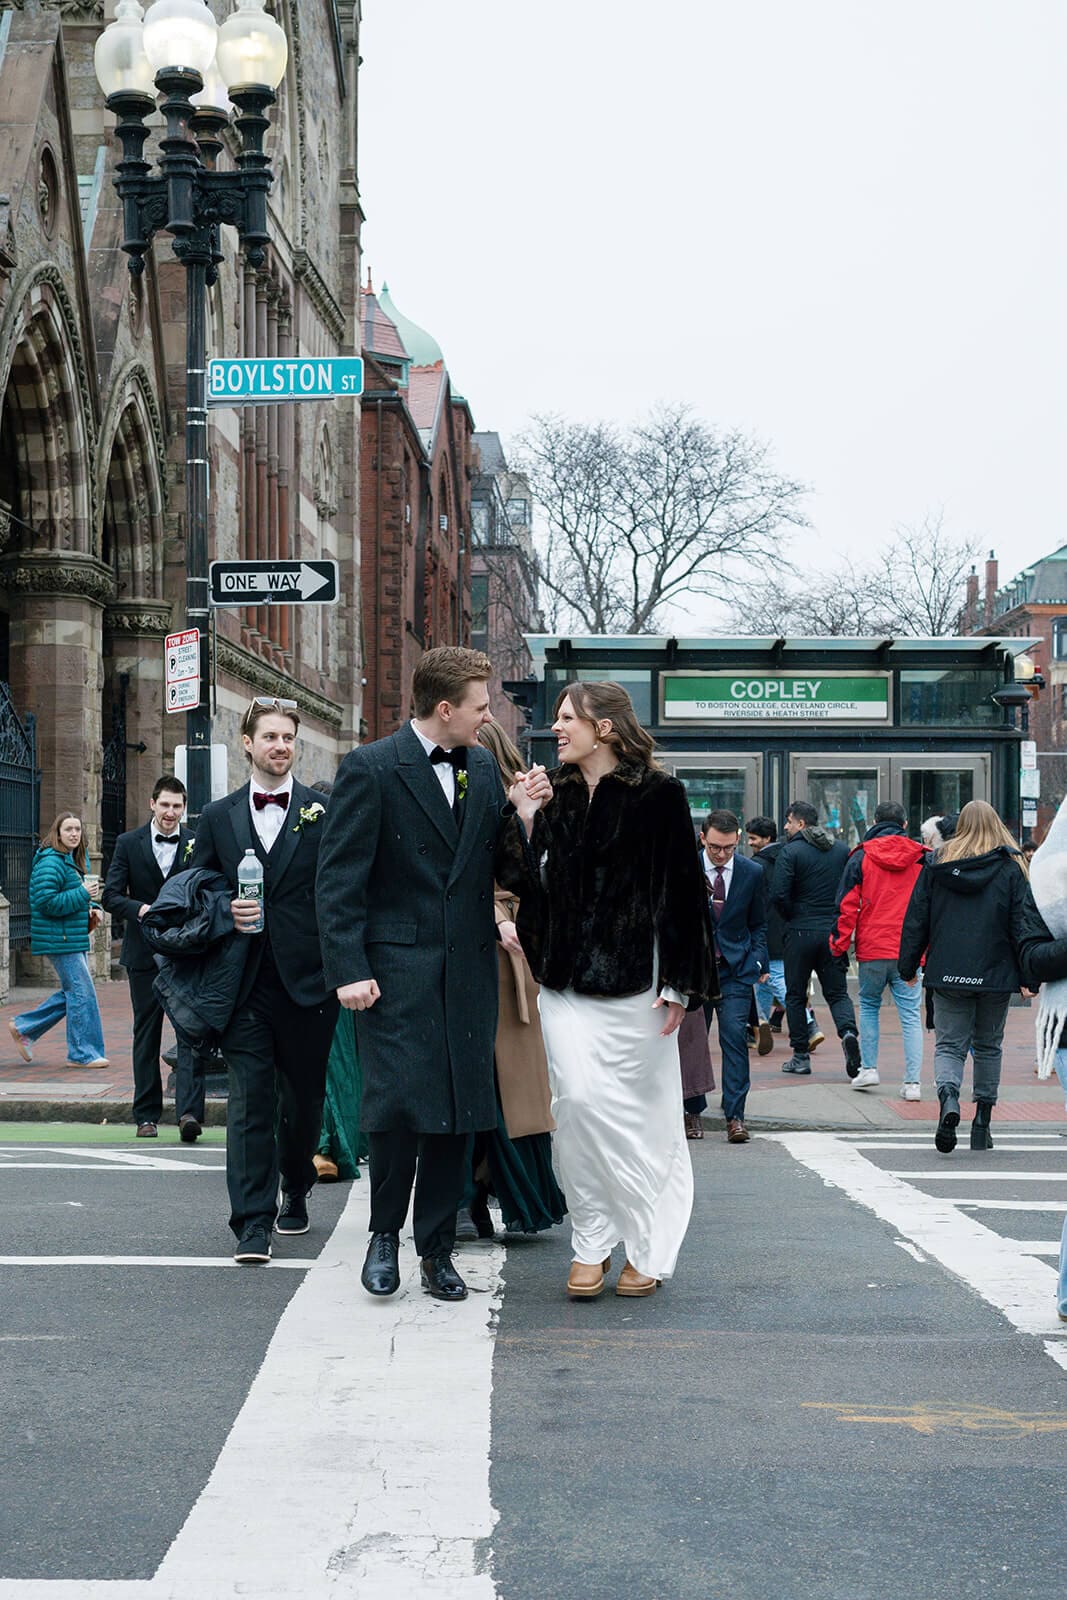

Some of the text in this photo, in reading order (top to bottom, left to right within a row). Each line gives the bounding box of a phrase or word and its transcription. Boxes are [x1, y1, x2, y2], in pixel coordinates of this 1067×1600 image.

[212, 363, 356, 392] BOYLSTON ST
[225, 574, 301, 590] ONE WAY
[168, 631, 198, 647] TOW ZONE
[178, 645, 193, 655] STREET
[177, 653, 197, 663] CLEANING
[730, 680, 822, 699] COPLEY
[741, 702, 779, 710] COLLEGE,
[827, 702, 858, 710] CIRCLE,
[942, 975, 984, 985] OUTDOOR
